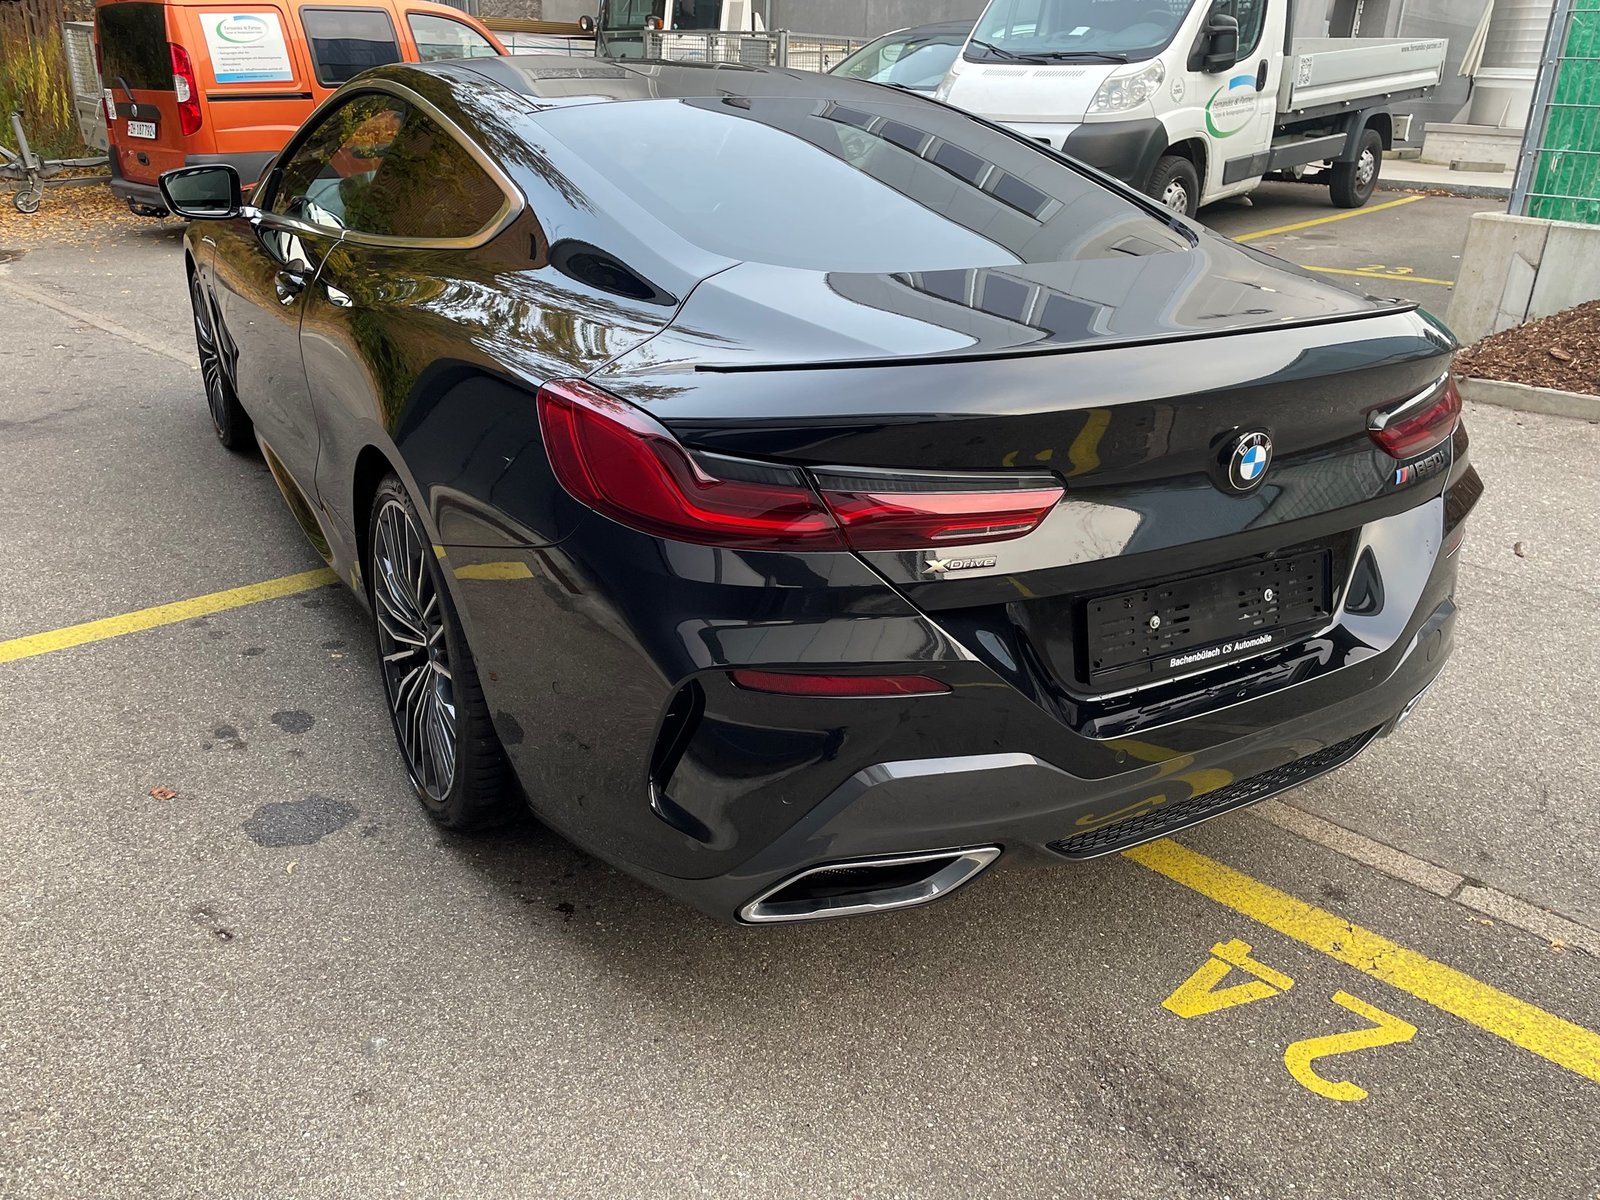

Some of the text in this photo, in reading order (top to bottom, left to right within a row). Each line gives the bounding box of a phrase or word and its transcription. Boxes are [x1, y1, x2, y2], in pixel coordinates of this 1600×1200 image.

[1238, 434, 1272, 456] BMW
[1169, 634, 1273, 668] Bachenbülach CS Automobile
[1161, 938, 1418, 1101] 24
